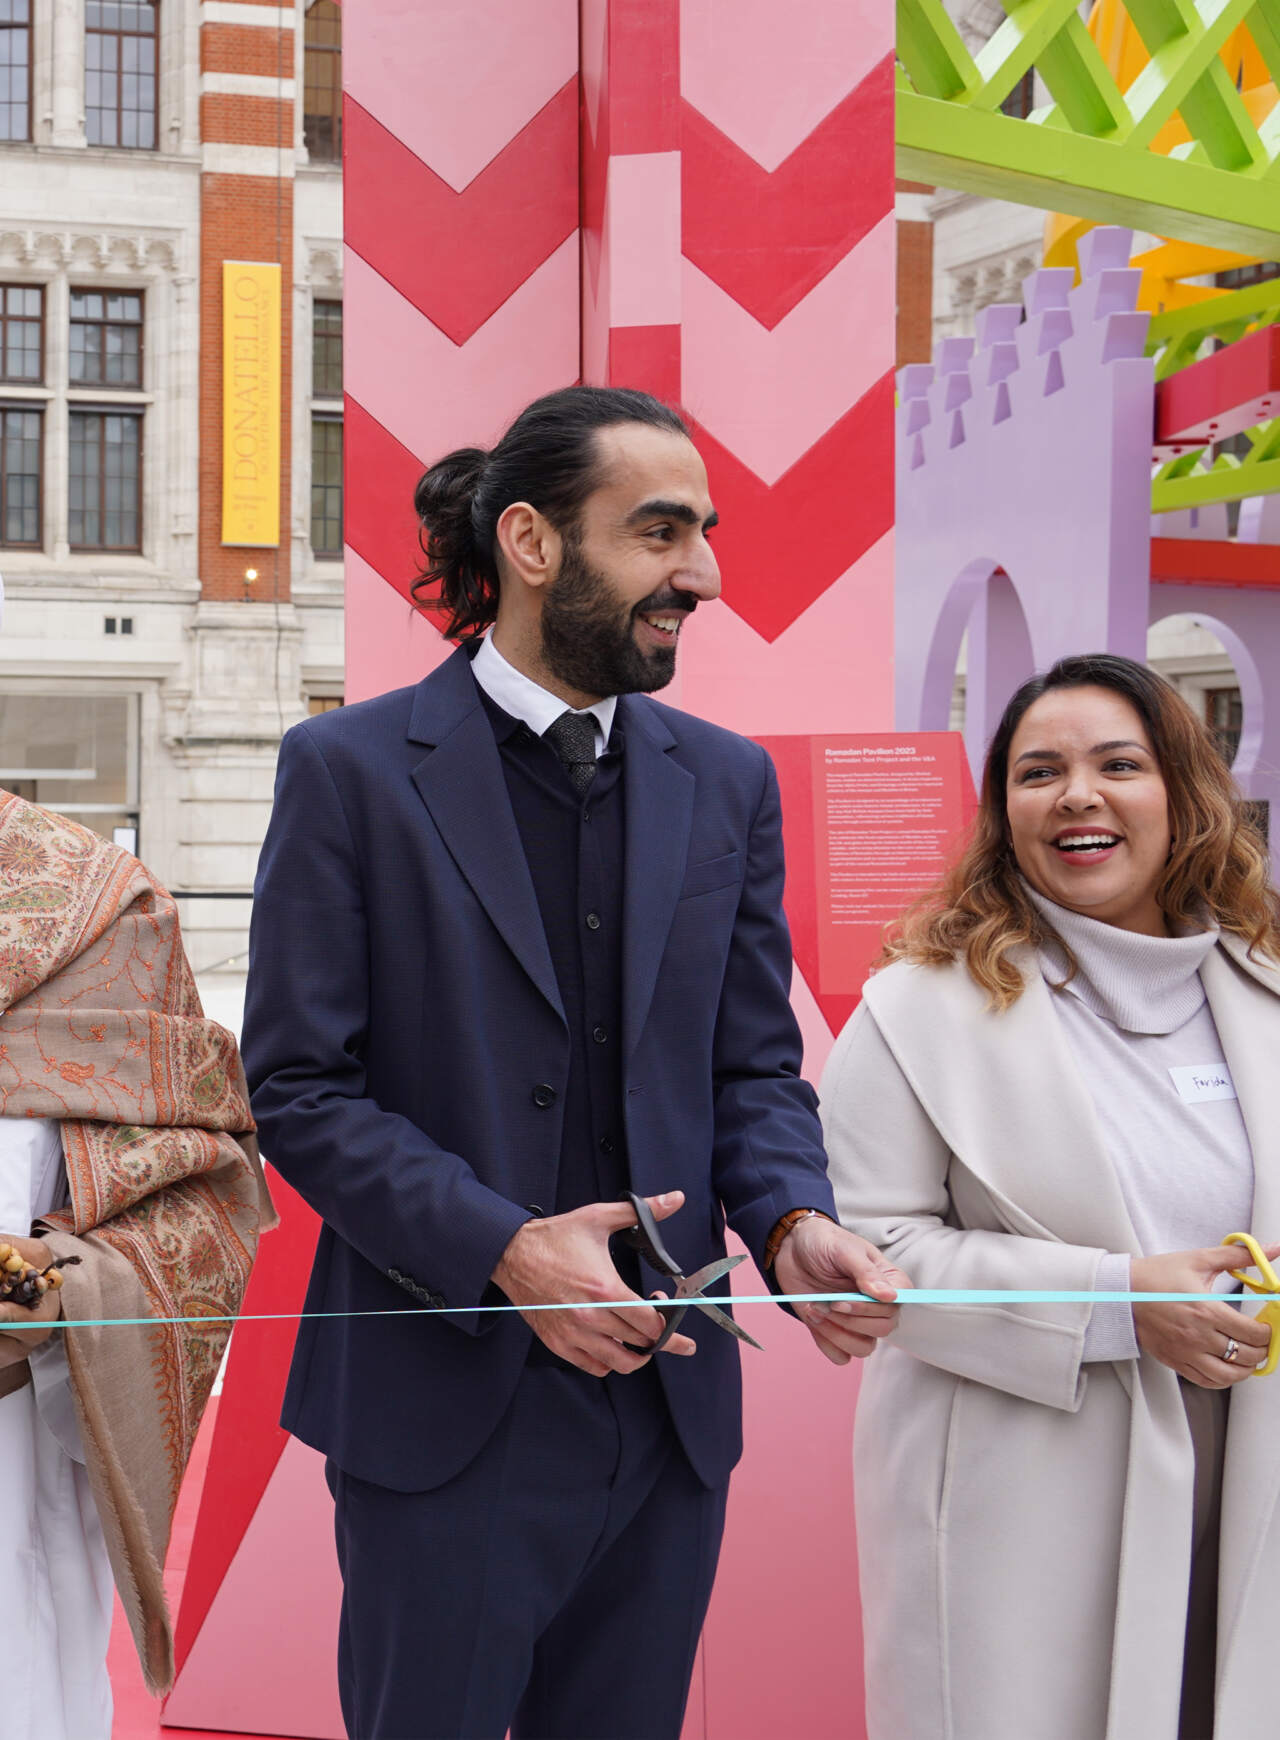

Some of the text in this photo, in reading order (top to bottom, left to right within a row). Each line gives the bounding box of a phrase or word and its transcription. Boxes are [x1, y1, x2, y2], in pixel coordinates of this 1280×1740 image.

[233, 275, 259, 481] DONATELLO
[825, 746, 916, 757] Ramadan Pavilion 2023
[876, 756, 899, 764] Project
